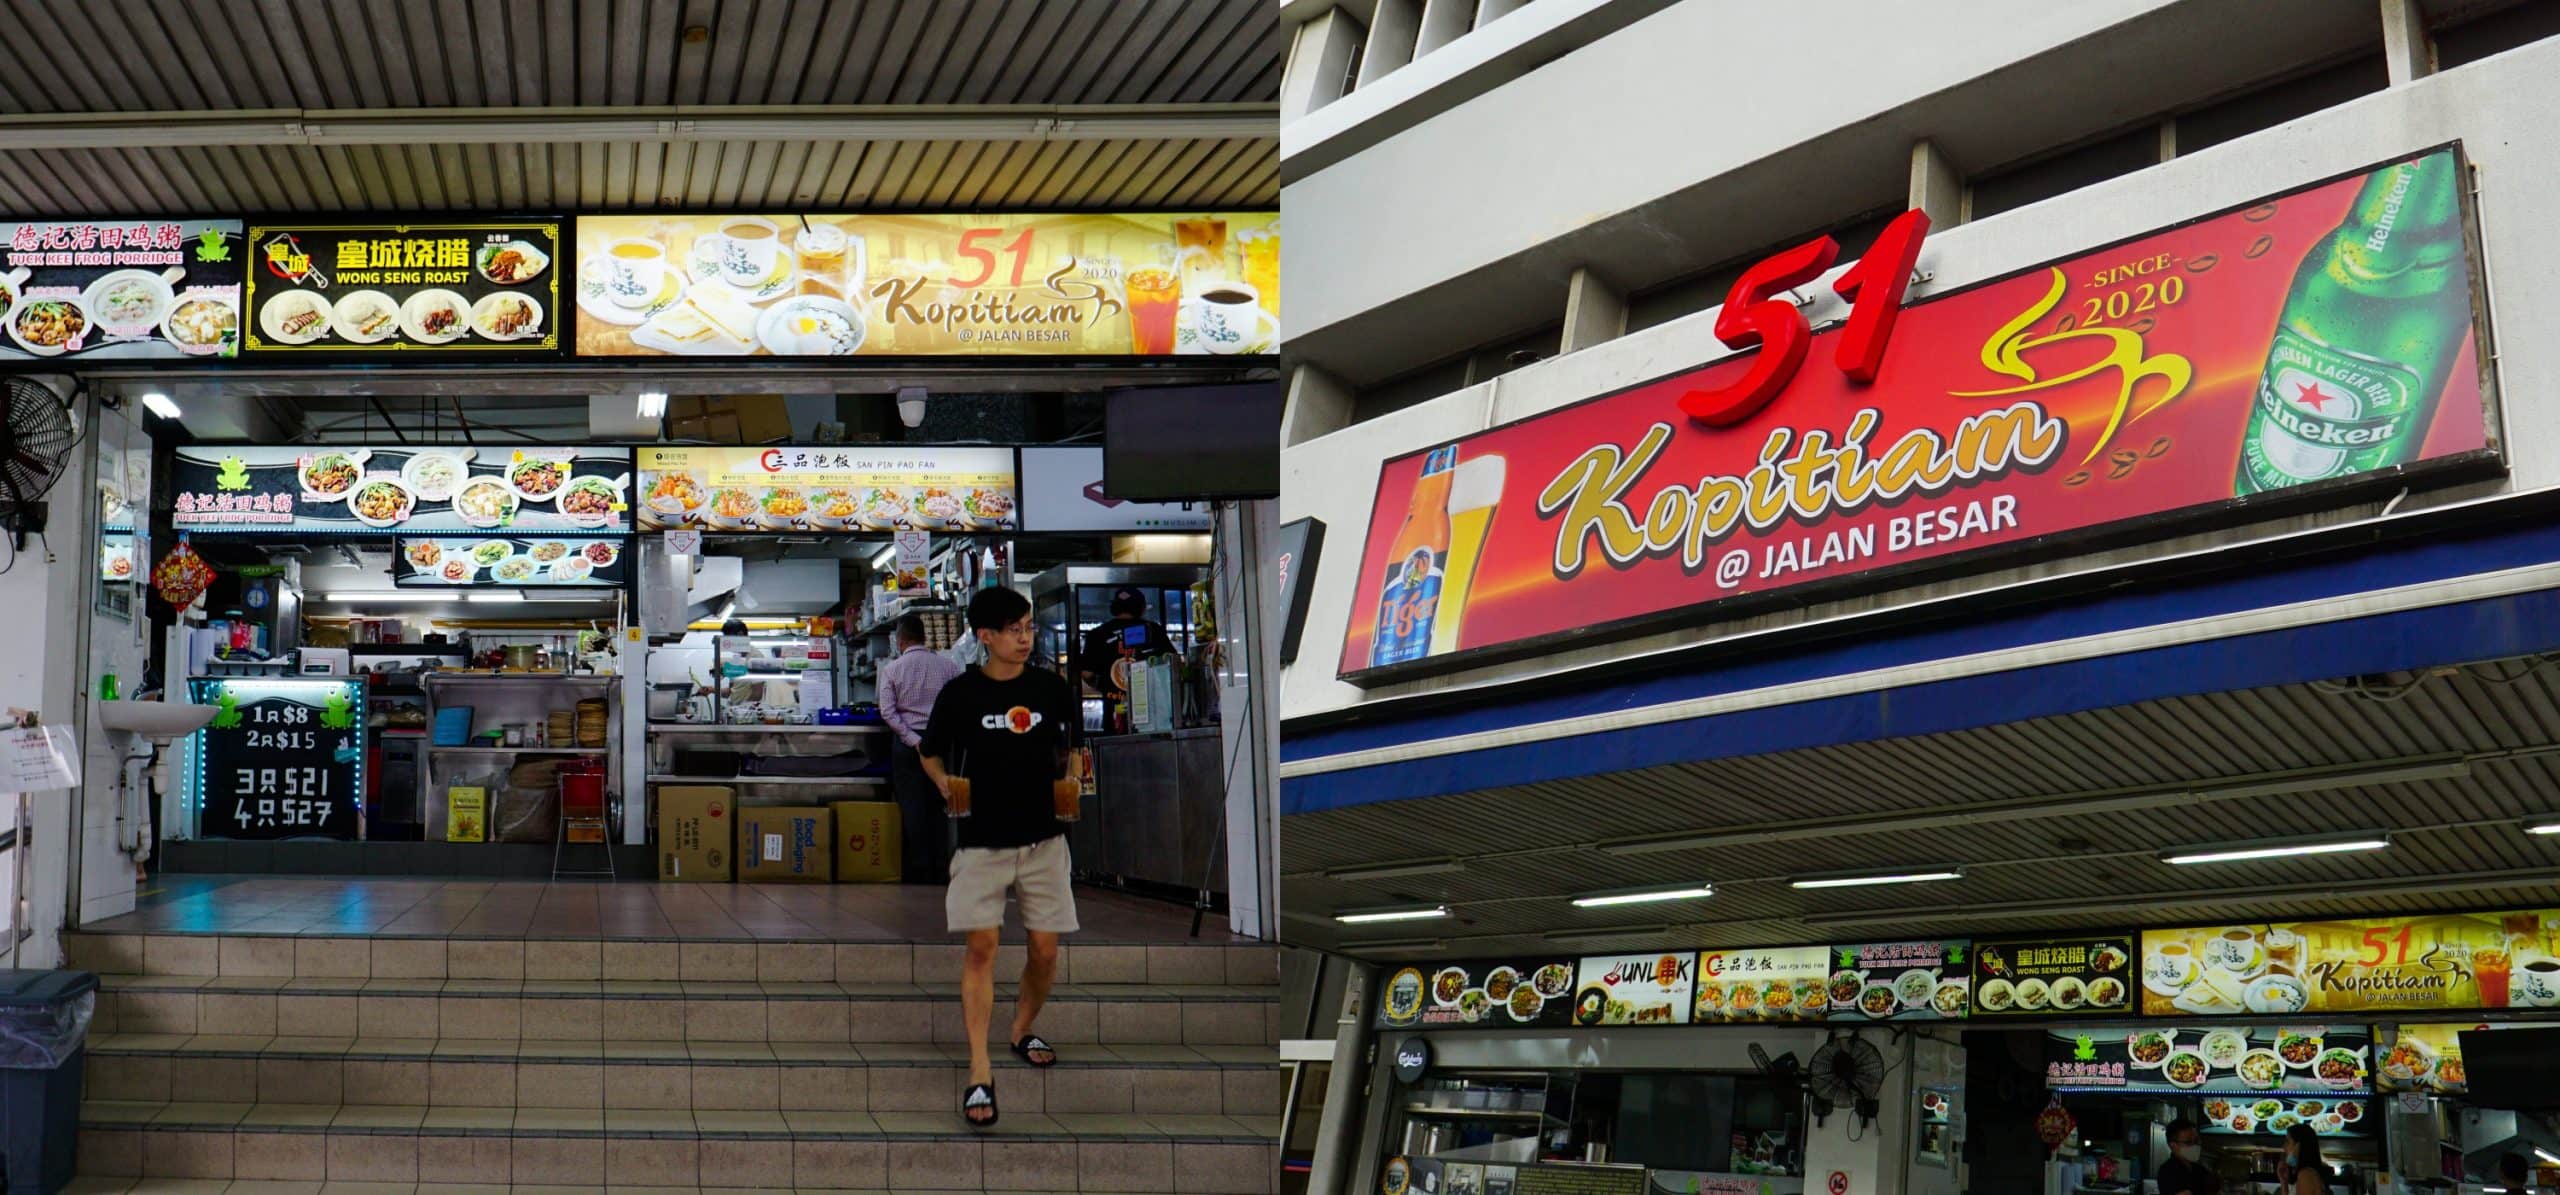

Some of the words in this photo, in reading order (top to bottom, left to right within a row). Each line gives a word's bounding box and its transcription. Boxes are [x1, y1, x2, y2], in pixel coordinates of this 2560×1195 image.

[2366, 173, 2412, 253] Heineken
[12, 223, 183, 251] 德记活田鸡粥
[337, 239, 470, 269] 皇城烧腊
[8, 252, 44, 266] TUCK
[46, 252, 72, 266] KEE
[75, 252, 112, 265] FROG
[113, 252, 183, 265] PORRIDGE
[947, 227, 1035, 289] 51
[1082, 268, 1118, 280] 2020
[336, 273, 380, 284] WONG
[383, 272, 421, 284] SENG
[425, 271, 470, 284] ROAST
[871, 275, 1084, 333] Kopitiam
[1677, 207, 1931, 429] 51
[2082, 275, 2184, 329] 2020
[959, 330, 974, 343] @
[977, 329, 1022, 342] JALAN
[1026, 329, 1071, 342] BESAR
[2316, 360, 2369, 389] LAGER
[2364, 382, 2393, 409] BEER
[772, 453, 851, 469] 三品泡饭
[856, 461, 873, 469] SAN
[877, 461, 893, 469] PIN
[897, 461, 914, 469] PAO
[918, 461, 936, 469] FAN
[1539, 402, 2065, 575] Kopitiam
[1716, 549, 1749, 588] @
[1759, 524, 1876, 579] JALAN
[1887, 494, 2018, 553] BESAR
[1380, 589, 1439, 638] Tiger
[2017, 946, 2086, 967] 皇城烧腊
[2357, 925, 2412, 968] 51
[2062, 965, 2085, 974] ROAST
[2312, 960, 2446, 996] Kopitiam
